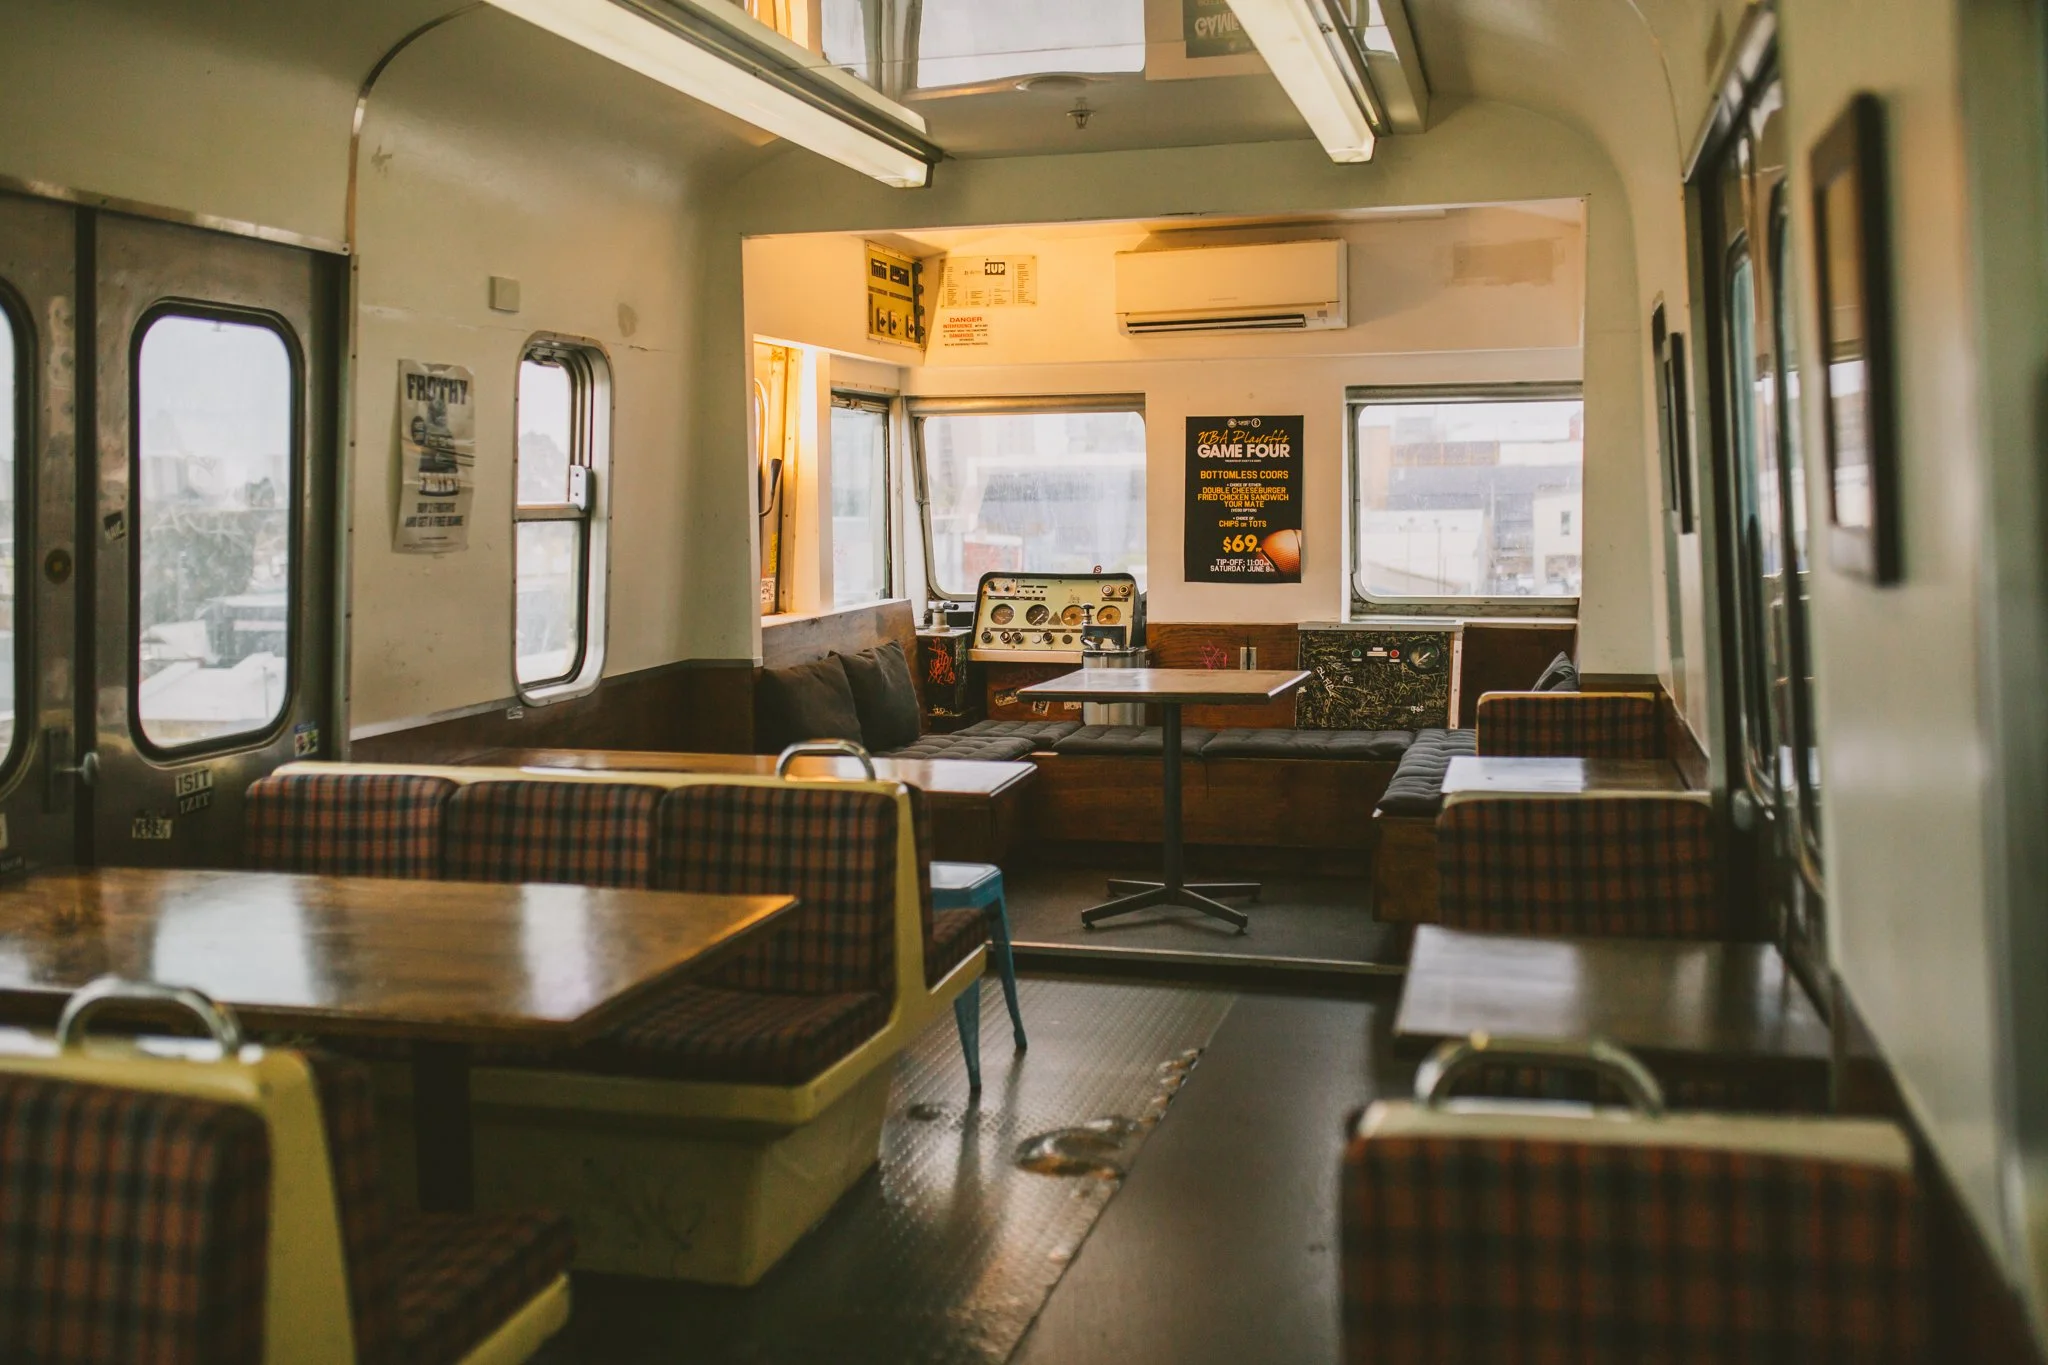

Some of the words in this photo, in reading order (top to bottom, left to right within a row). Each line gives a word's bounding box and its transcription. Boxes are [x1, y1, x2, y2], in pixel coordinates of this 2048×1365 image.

[406, 373, 468, 405] FROTHY
[1198, 429, 1229, 445] NBA
[1233, 429, 1290, 446] Playoffs
[1197, 444, 1243, 458] GAME
[1246, 444, 1290, 458] FOUR
[1200, 470, 1258, 479] BOTTOMLESS
[1260, 470, 1289, 479] COORS
